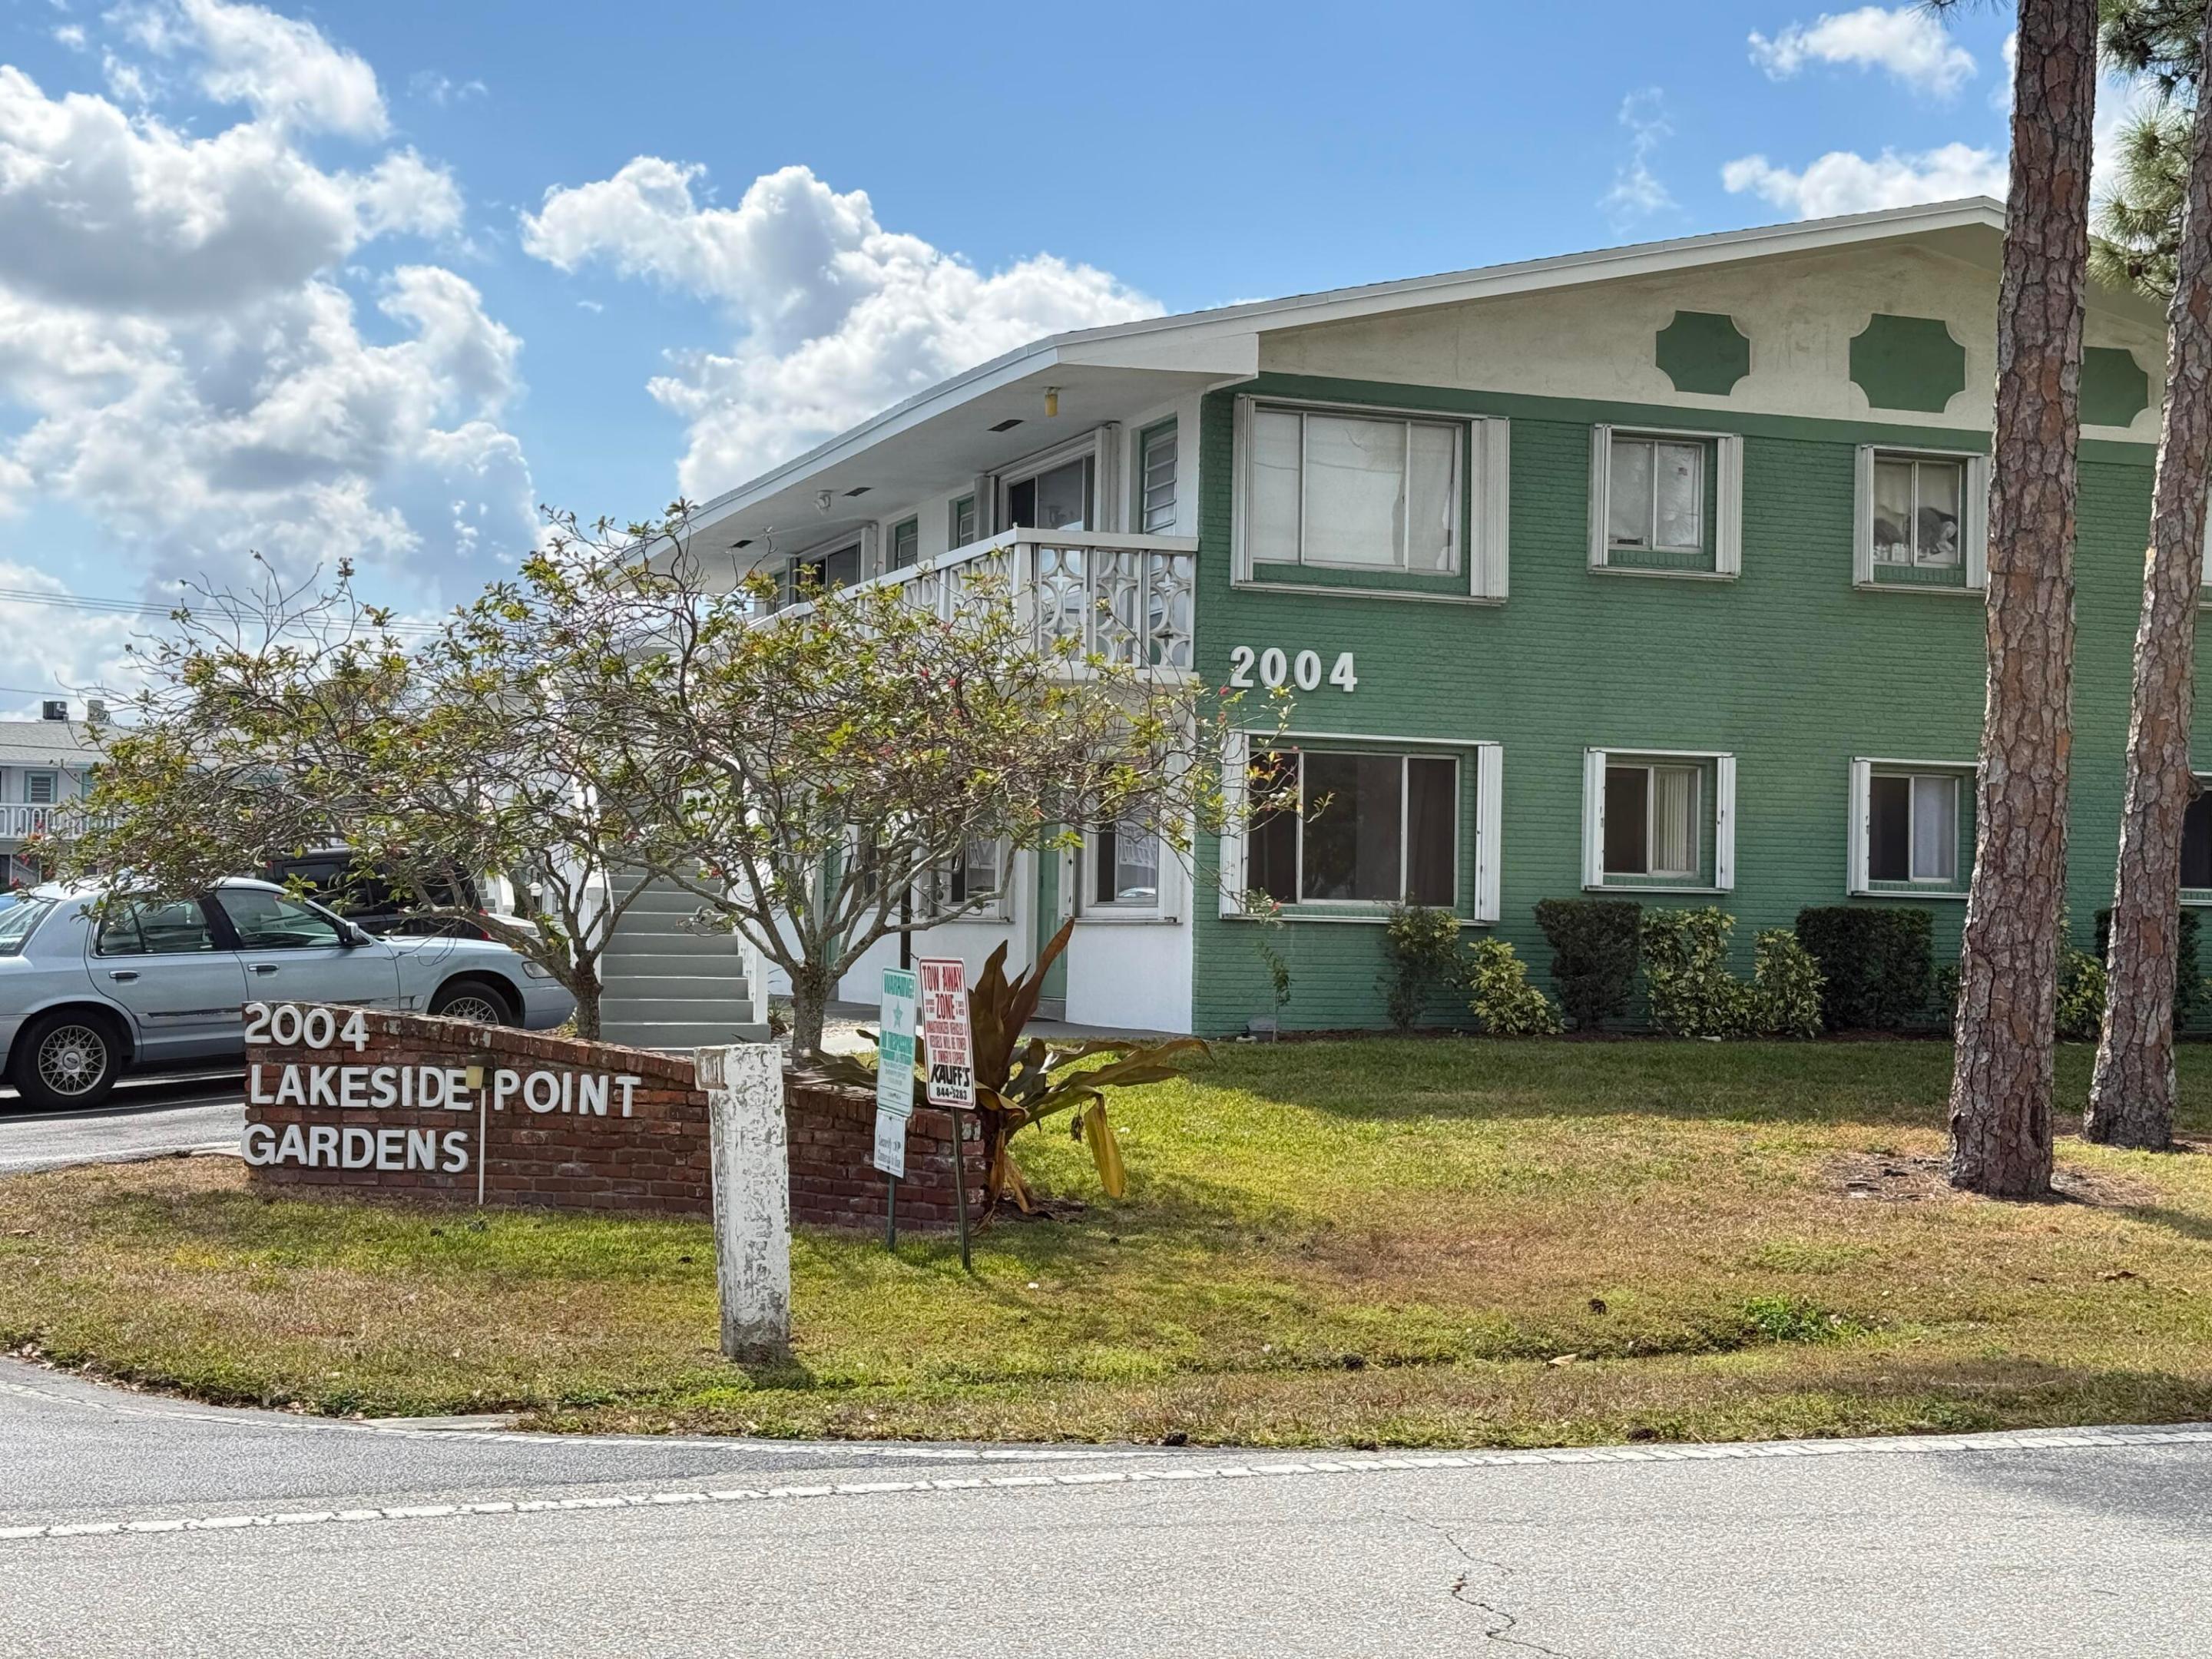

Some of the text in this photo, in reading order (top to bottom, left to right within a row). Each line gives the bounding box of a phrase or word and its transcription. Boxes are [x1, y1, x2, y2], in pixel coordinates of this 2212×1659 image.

[1230, 645, 1358, 692] 2004
[922, 965, 962, 992] TOW AWAY
[244, 1002, 369, 1051] 2004
[935, 993, 955, 1020] ZONE
[250, 1064, 641, 1118] LAKESIDE POINT
[930, 1063, 970, 1087] KAUFF'S
[240, 1123, 469, 1174] GARDENS
